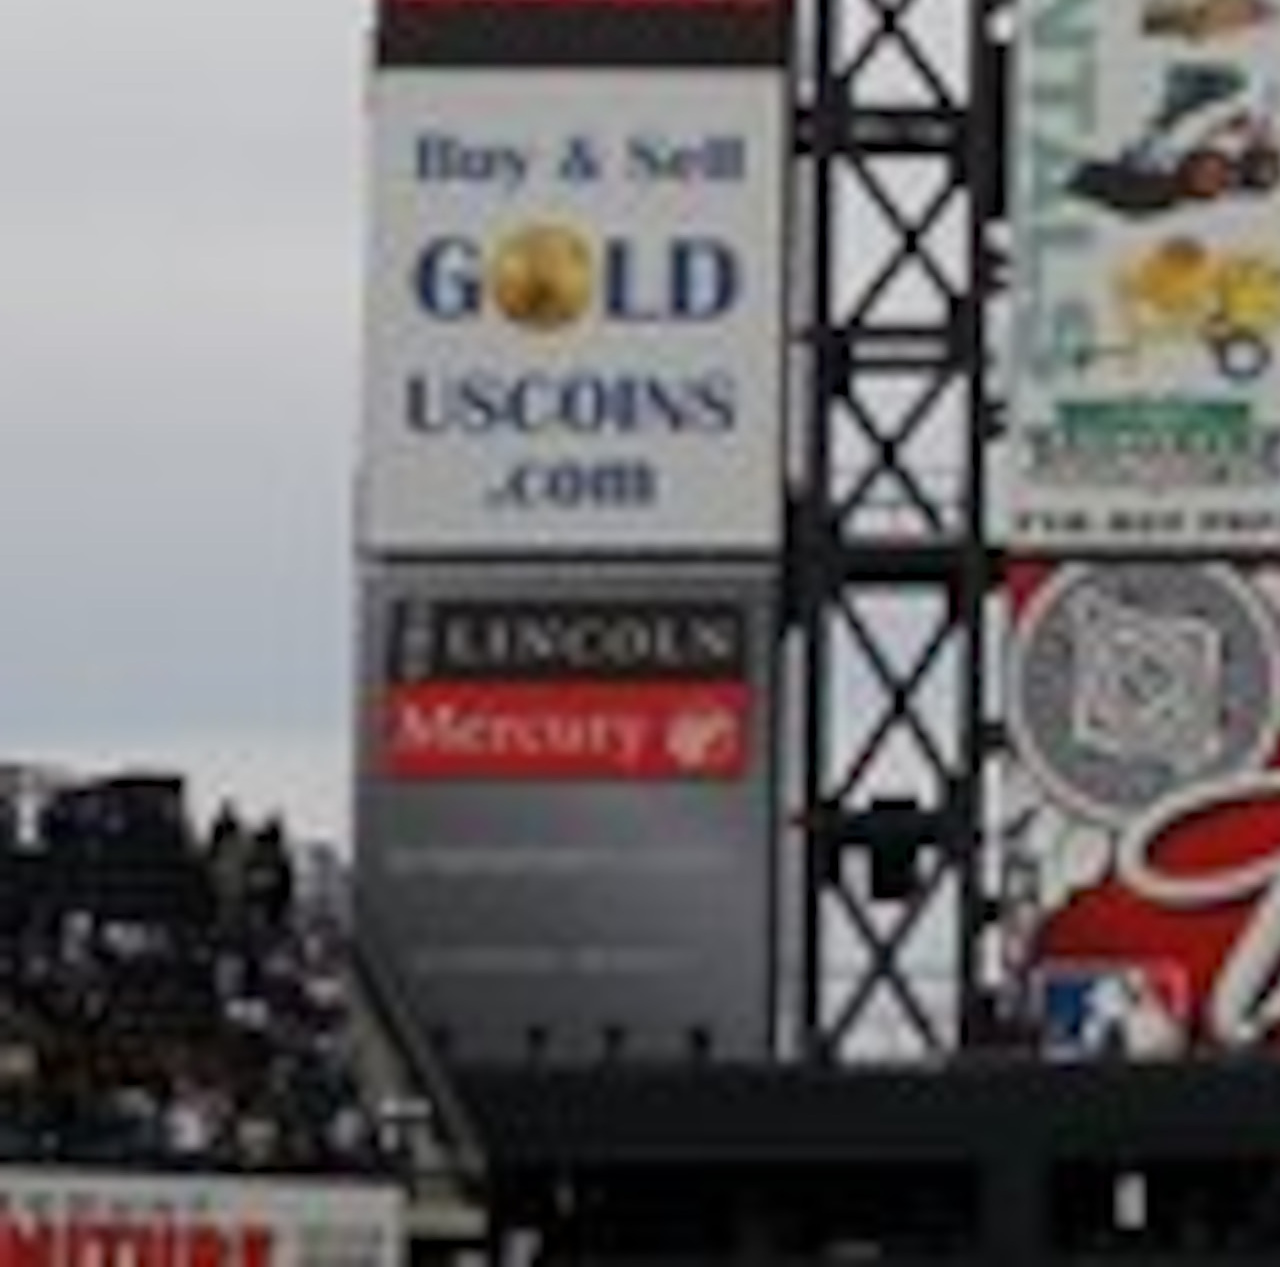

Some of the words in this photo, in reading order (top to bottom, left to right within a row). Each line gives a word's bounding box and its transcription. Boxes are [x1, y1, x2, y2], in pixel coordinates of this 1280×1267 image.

[415, 135, 527, 191] Buy
[558, 135, 600, 182] &
[625, 135, 748, 182] Sell
[412, 227, 738, 329] GOLD
[405, 373, 738, 433] USCOINS
[484, 461, 660, 509] .com
[444, 615, 736, 667] LINCOLN
[394, 703, 652, 771] Mercury
